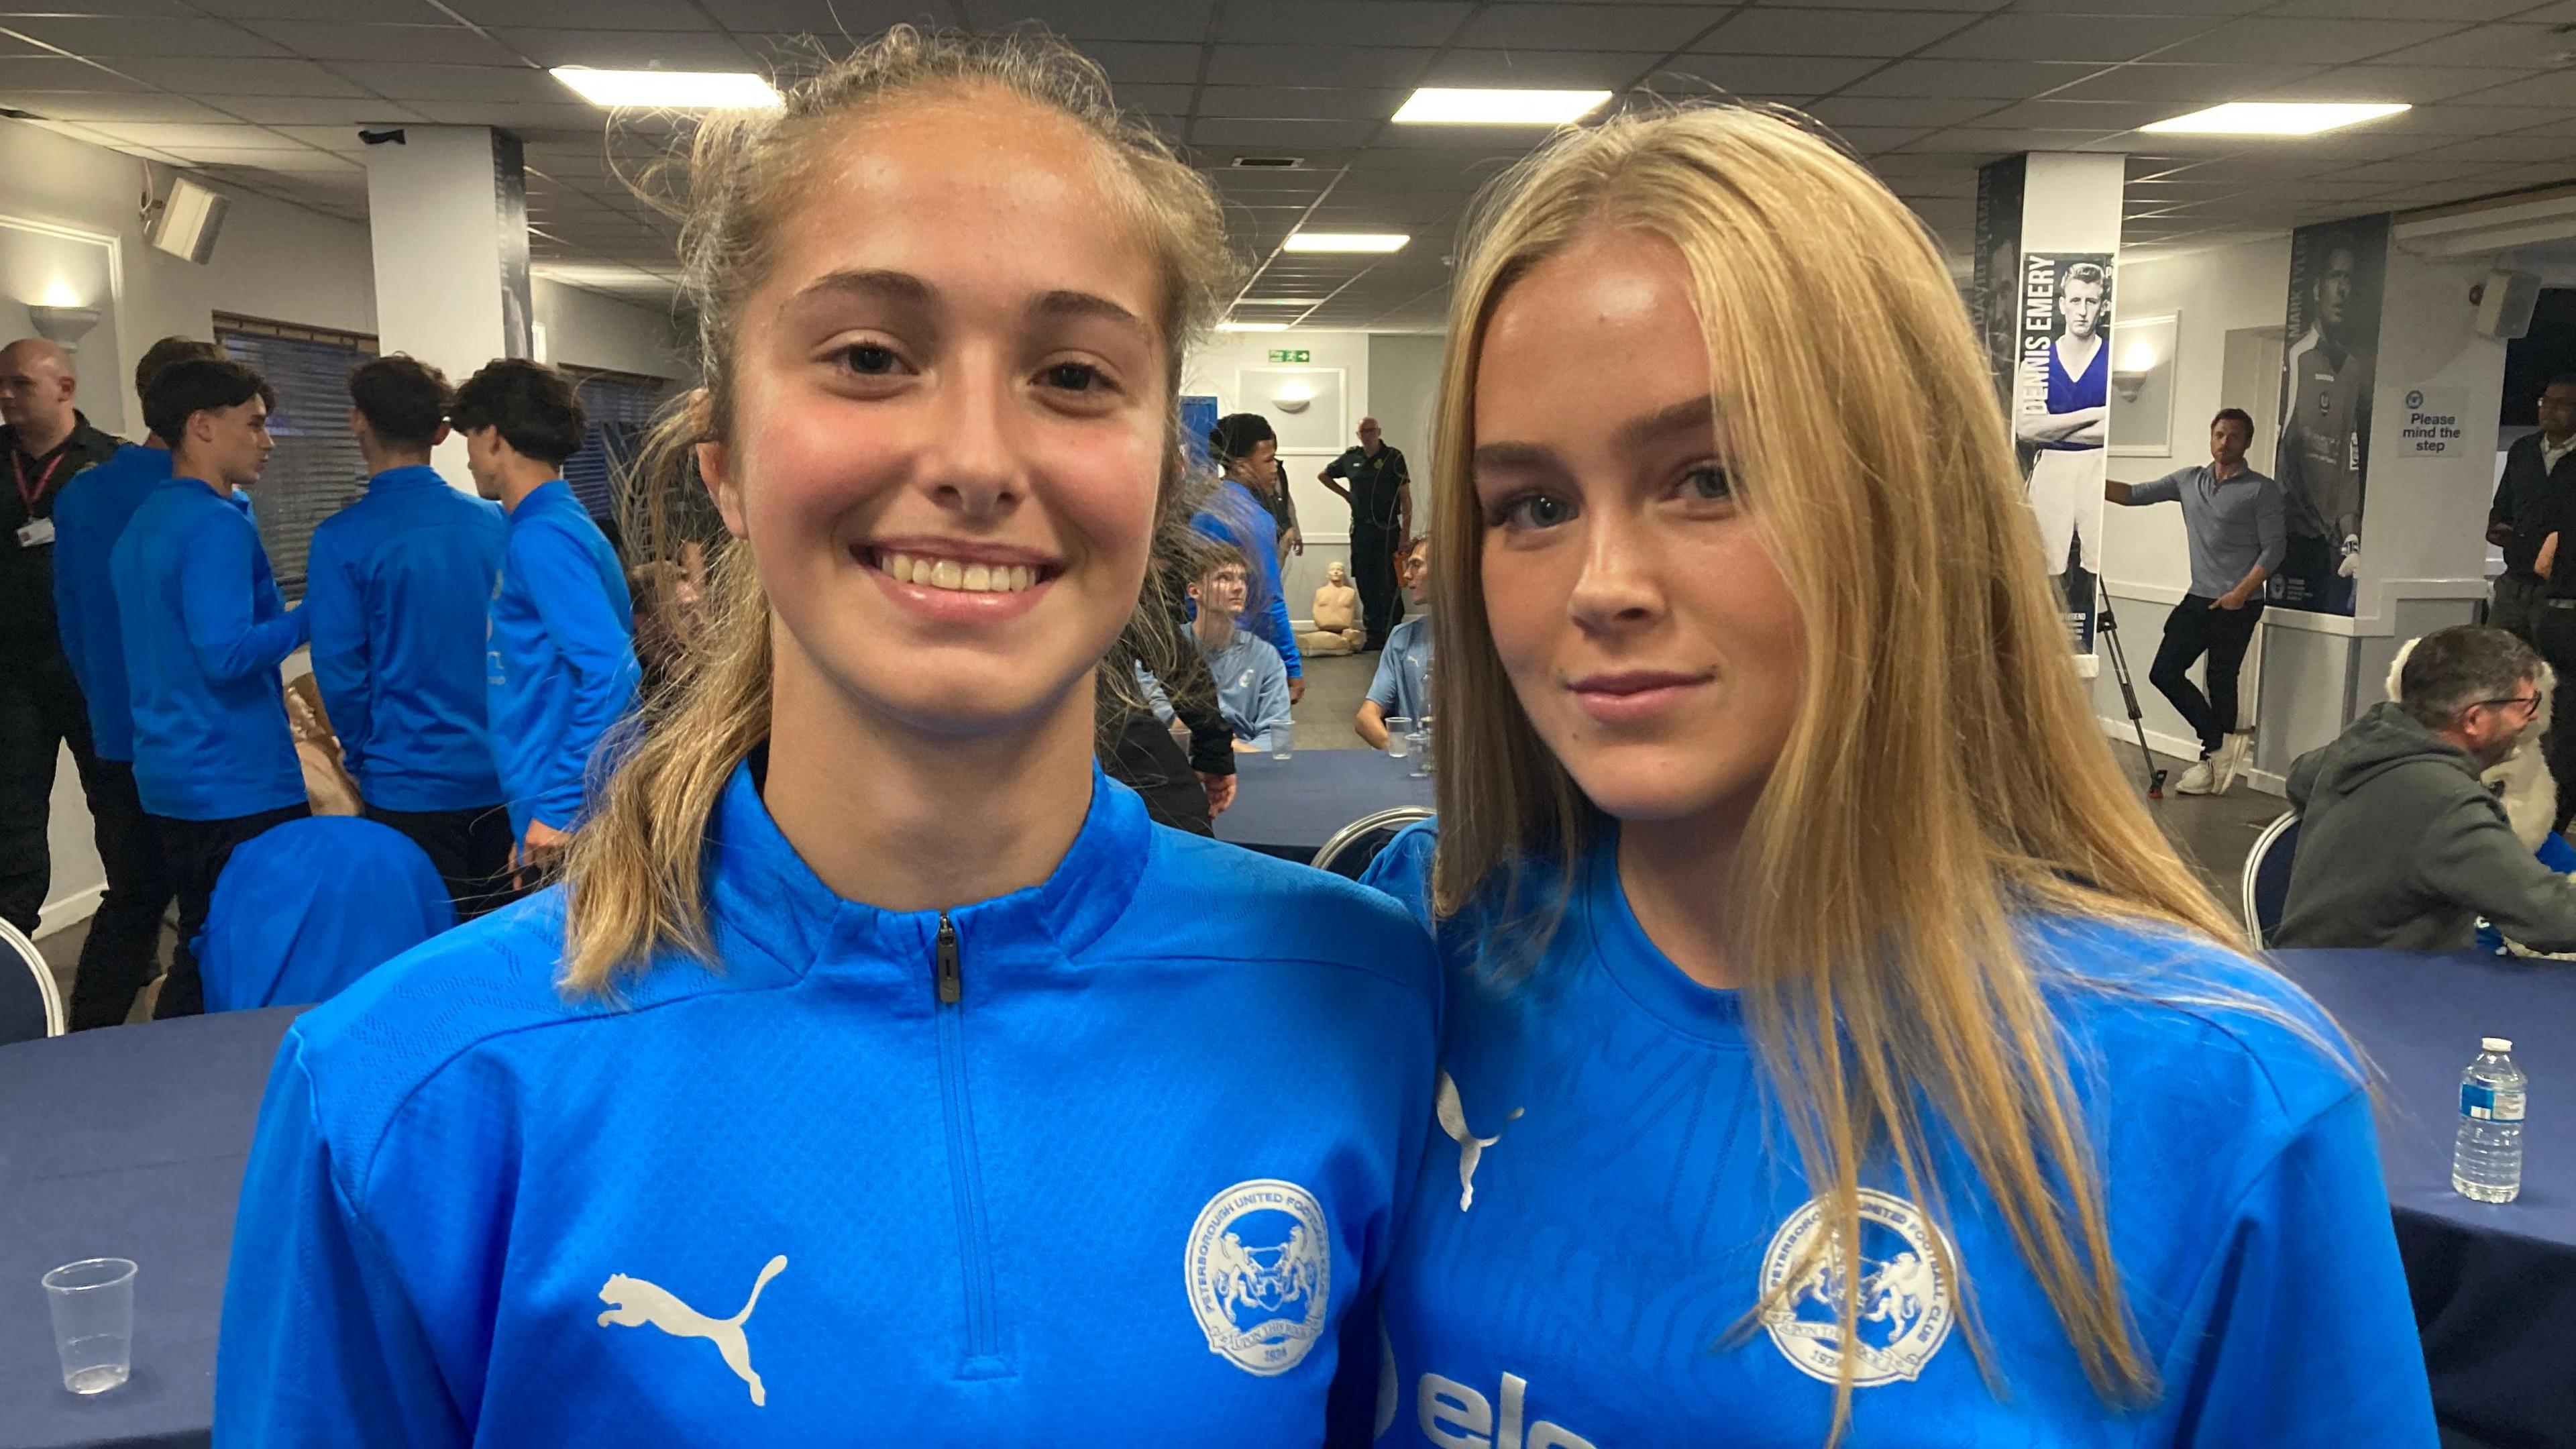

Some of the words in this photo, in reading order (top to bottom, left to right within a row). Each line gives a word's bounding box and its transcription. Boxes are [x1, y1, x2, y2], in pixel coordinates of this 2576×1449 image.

[2025, 256, 2055, 331] EMERY
[2023, 336, 2051, 416] DENNIS
[2402, 427, 2436, 438] mind
[2440, 426, 2461, 438] the
[2410, 413, 2456, 425] Please
[2416, 440, 2446, 454] step
[1197, 1203, 1235, 1313] PETERBOROUGH
[1234, 1193, 1283, 1208] UNITED
[1770, 1210, 1822, 1287] PETERBORO
[1917, 1305, 1941, 1343] CLUB
